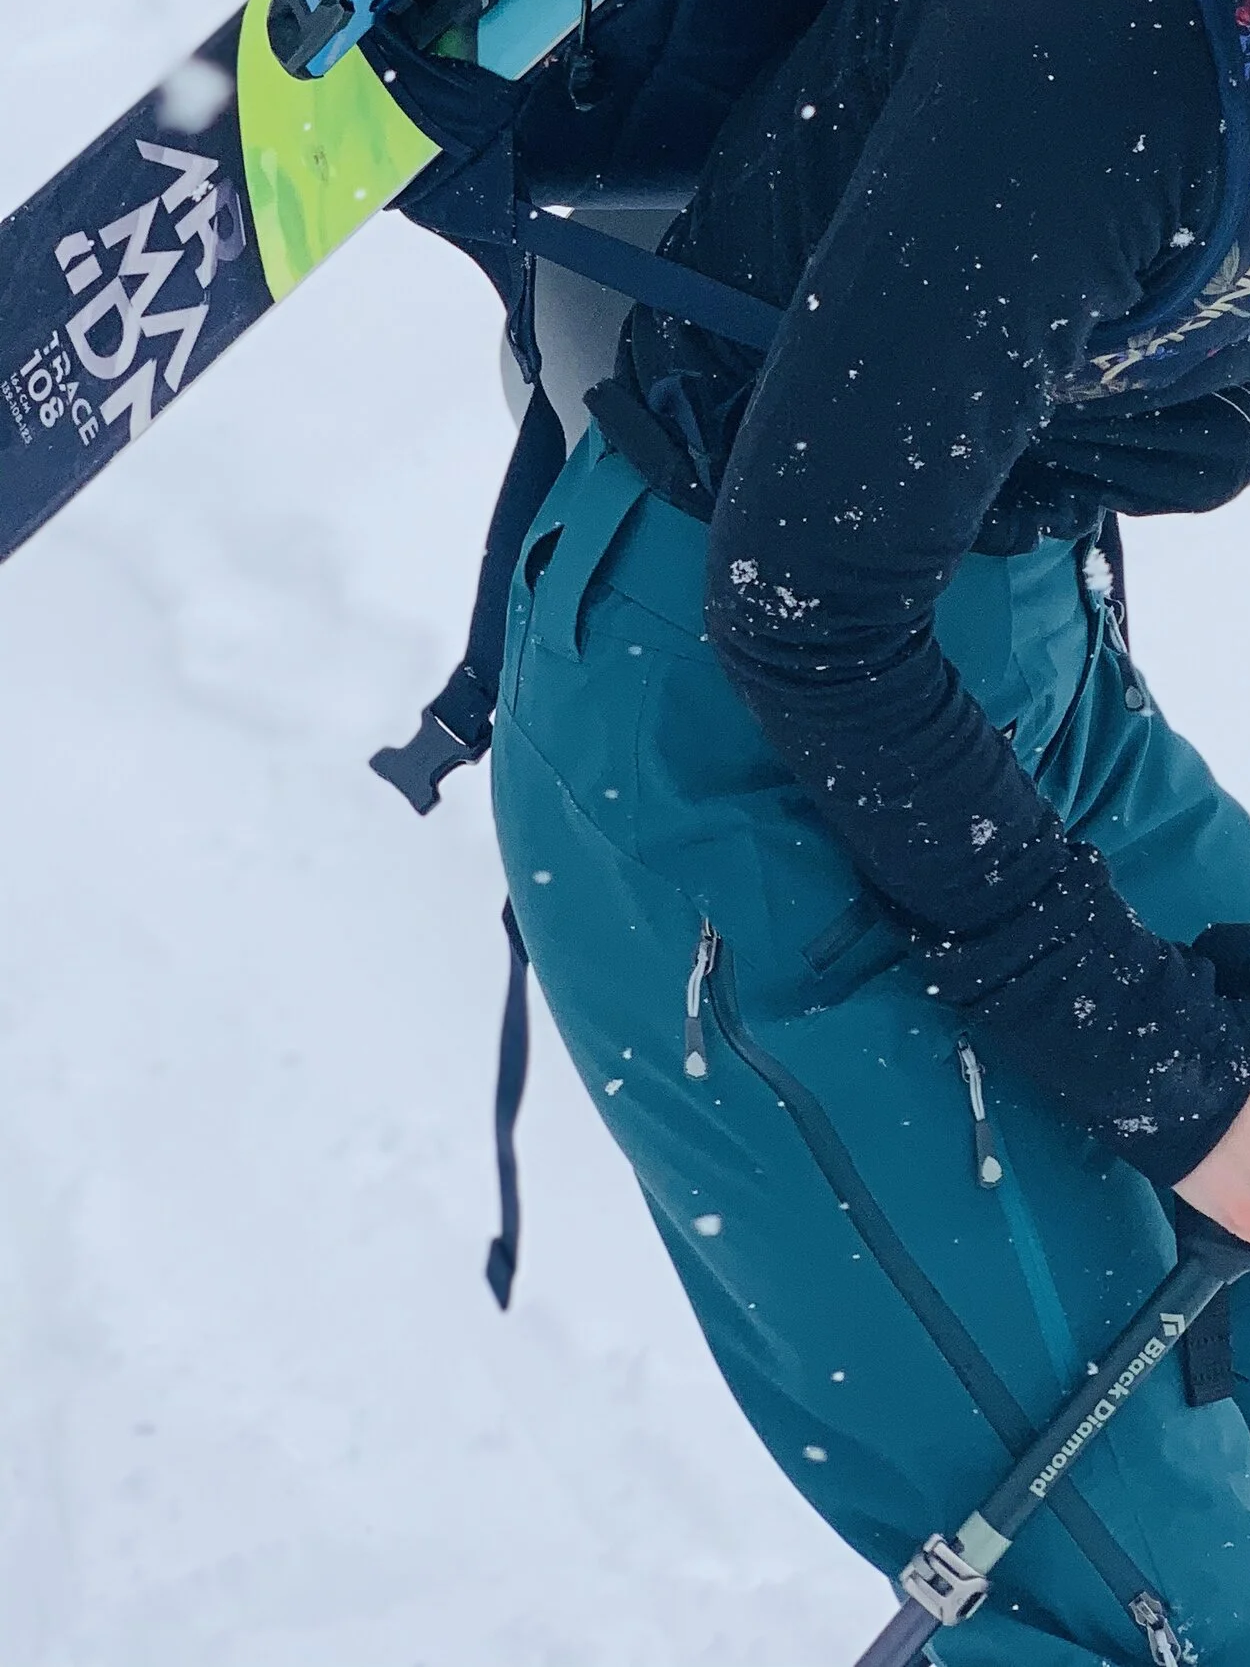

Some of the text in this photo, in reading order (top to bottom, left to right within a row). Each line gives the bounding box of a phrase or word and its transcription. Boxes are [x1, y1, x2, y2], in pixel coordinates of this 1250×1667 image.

[1, 380, 33, 444] 132-108-125
[10, 372, 31, 414] 164 CM
[20, 348, 65, 428] 108
[43, 330, 99, 446] TRACE
[1029, 1337, 1166, 1498] Black Diamond
